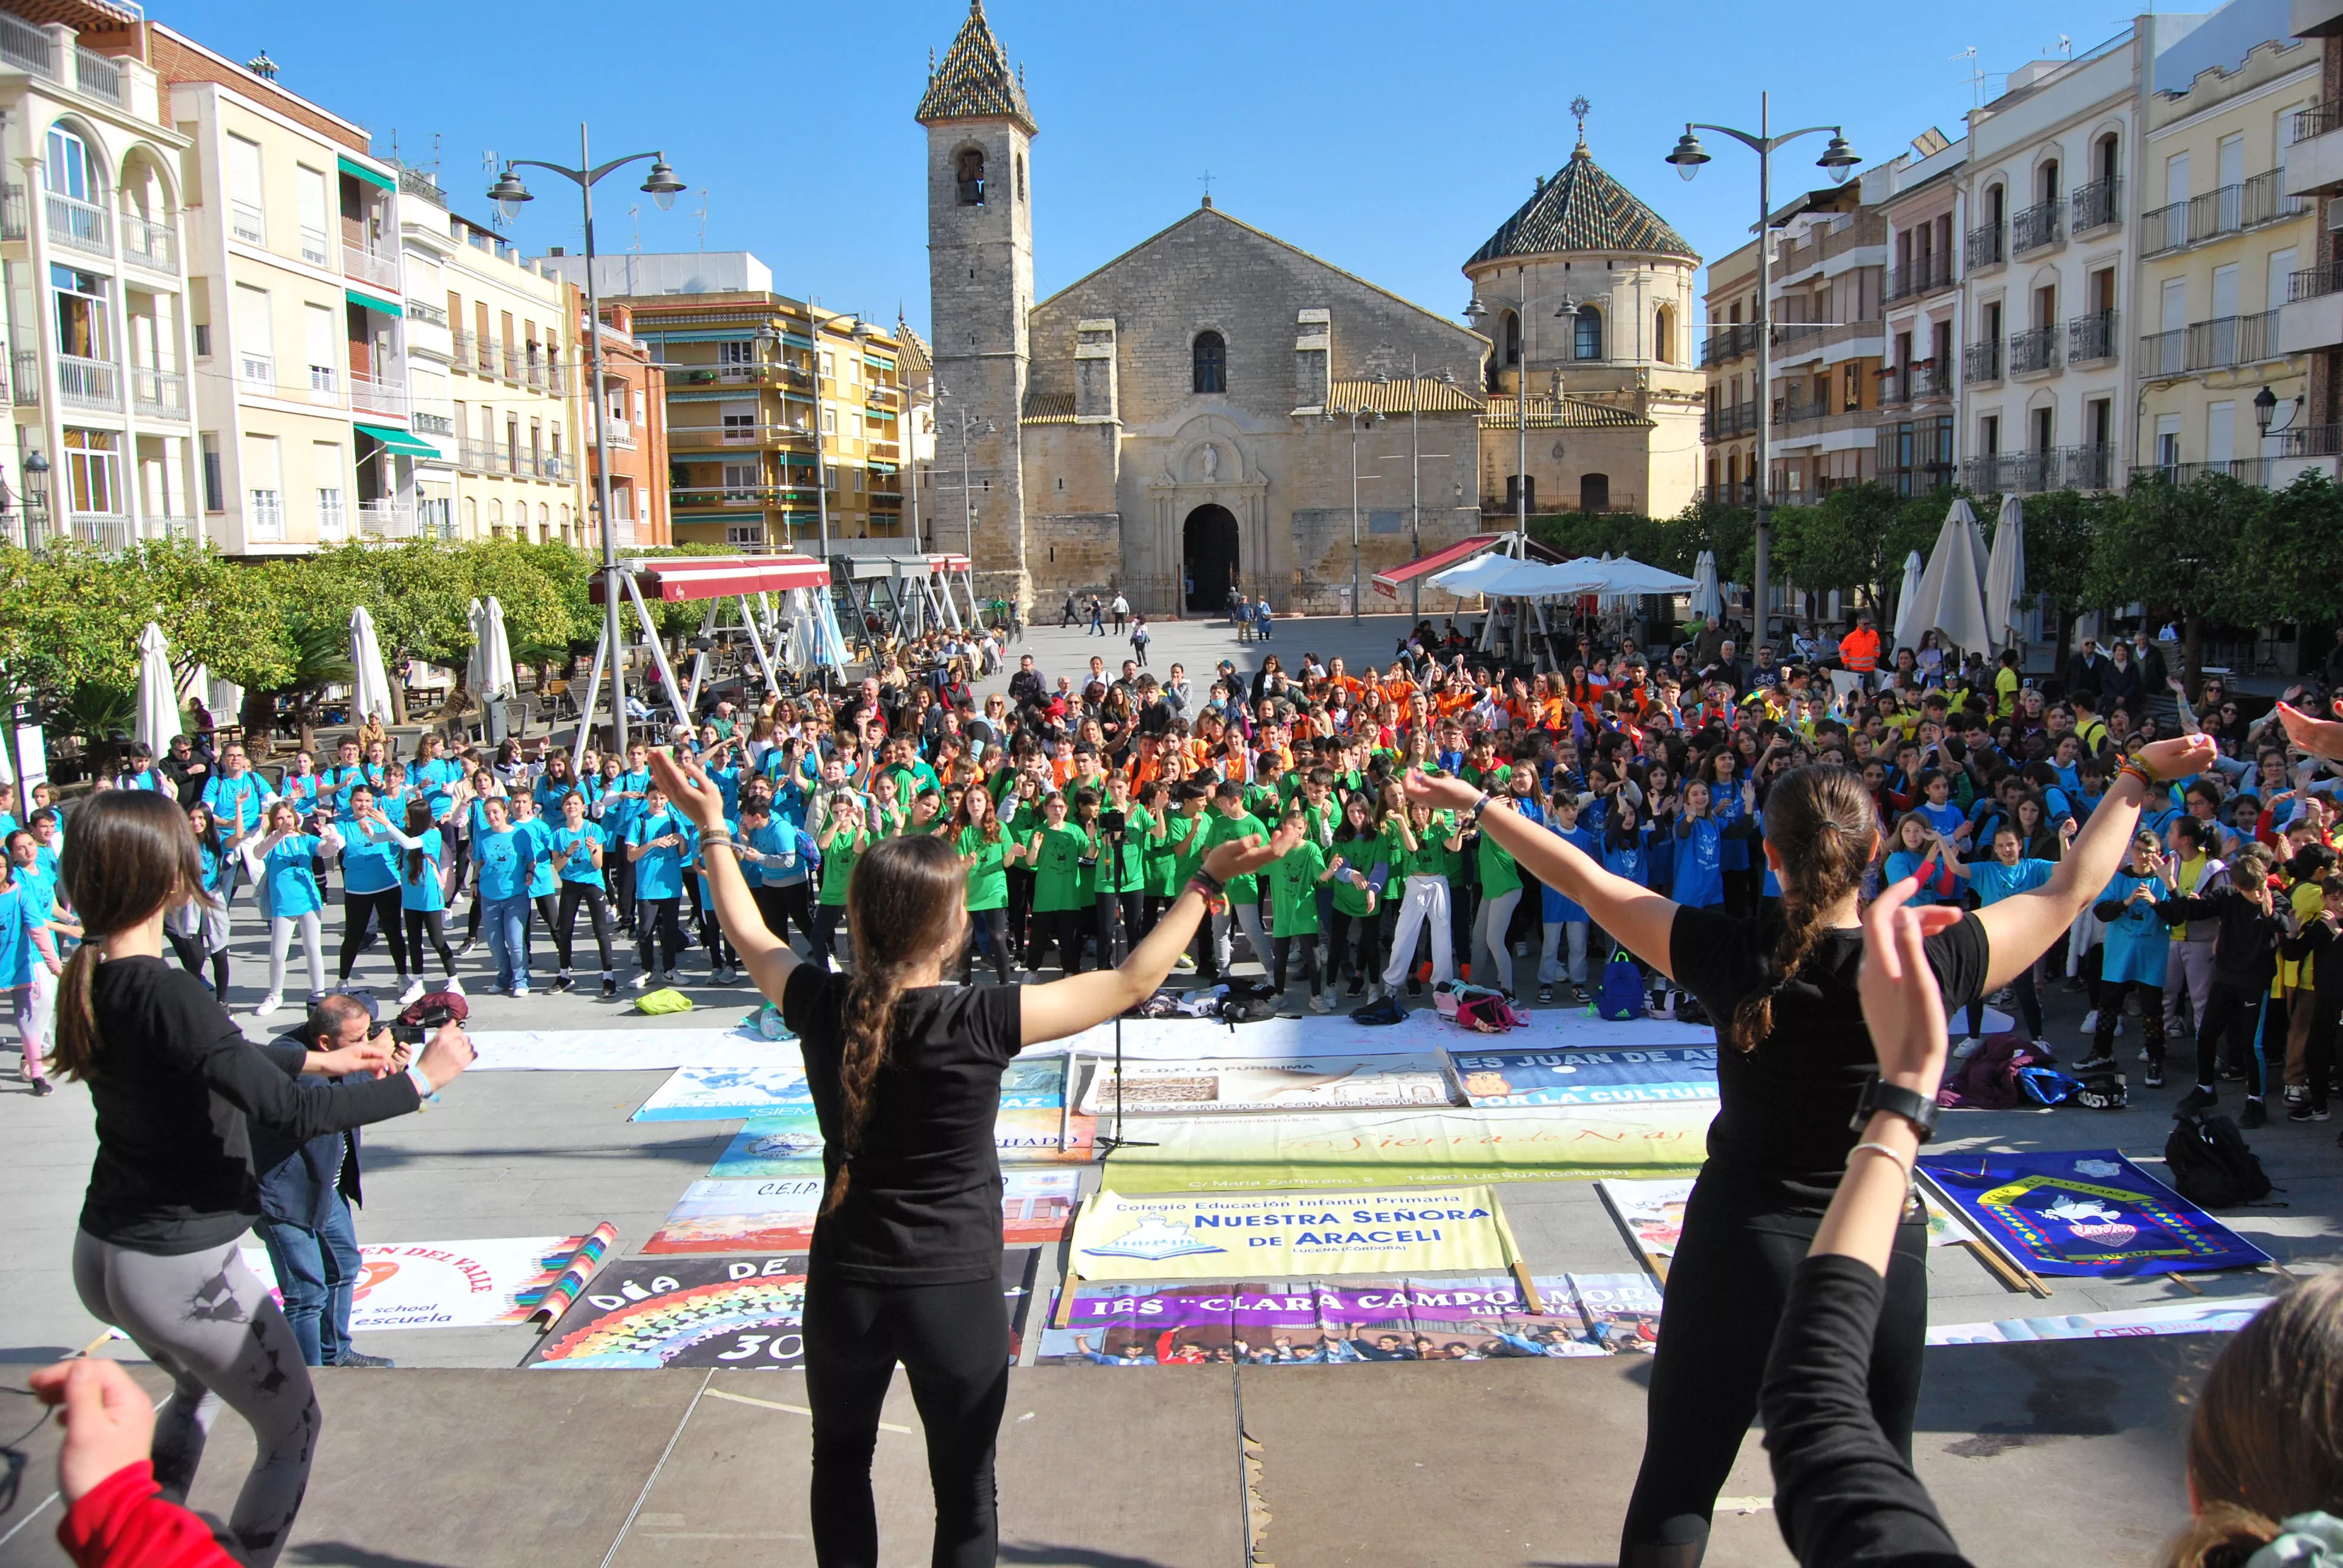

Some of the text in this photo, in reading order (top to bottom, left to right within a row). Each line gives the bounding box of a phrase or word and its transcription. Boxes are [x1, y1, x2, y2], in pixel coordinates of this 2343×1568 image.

[1516, 1052, 1613, 1067] JUAN
[1621, 1050, 1674, 1063] DE
[1130, 1103, 1169, 1113] Paz
[1169, 1101, 1279, 1112] comienza
[1283, 1099, 1325, 1109] con
[1326, 1097, 1365, 1107] una
[1365, 1096, 1449, 1106] sonrisa
[1539, 1092, 1581, 1104] LA
[1517, 1130, 1560, 1142] de
[1570, 1129, 1693, 1144] Aras
[1463, 1171, 1541, 1180] LUCENA
[758, 1182, 819, 1196] C.E.I.P.
[1116, 1194, 1461, 1212] Colegio Educación Infantil Primaria
[1194, 1208, 1490, 1228] NUESTRA SEÑORA
[1248, 1229, 1442, 1247] DE ARACELI
[401, 1247, 455, 1263] DEL
[452, 1258, 493, 1293] VALLE
[728, 1257, 789, 1280] DE
[372, 1304, 438, 1314] school
[1092, 1298, 1164, 1316] IES
[1469, 1302, 1575, 1318] LUCNA
[355, 1313, 453, 1326] escuela
[717, 1334, 804, 1361] 30
